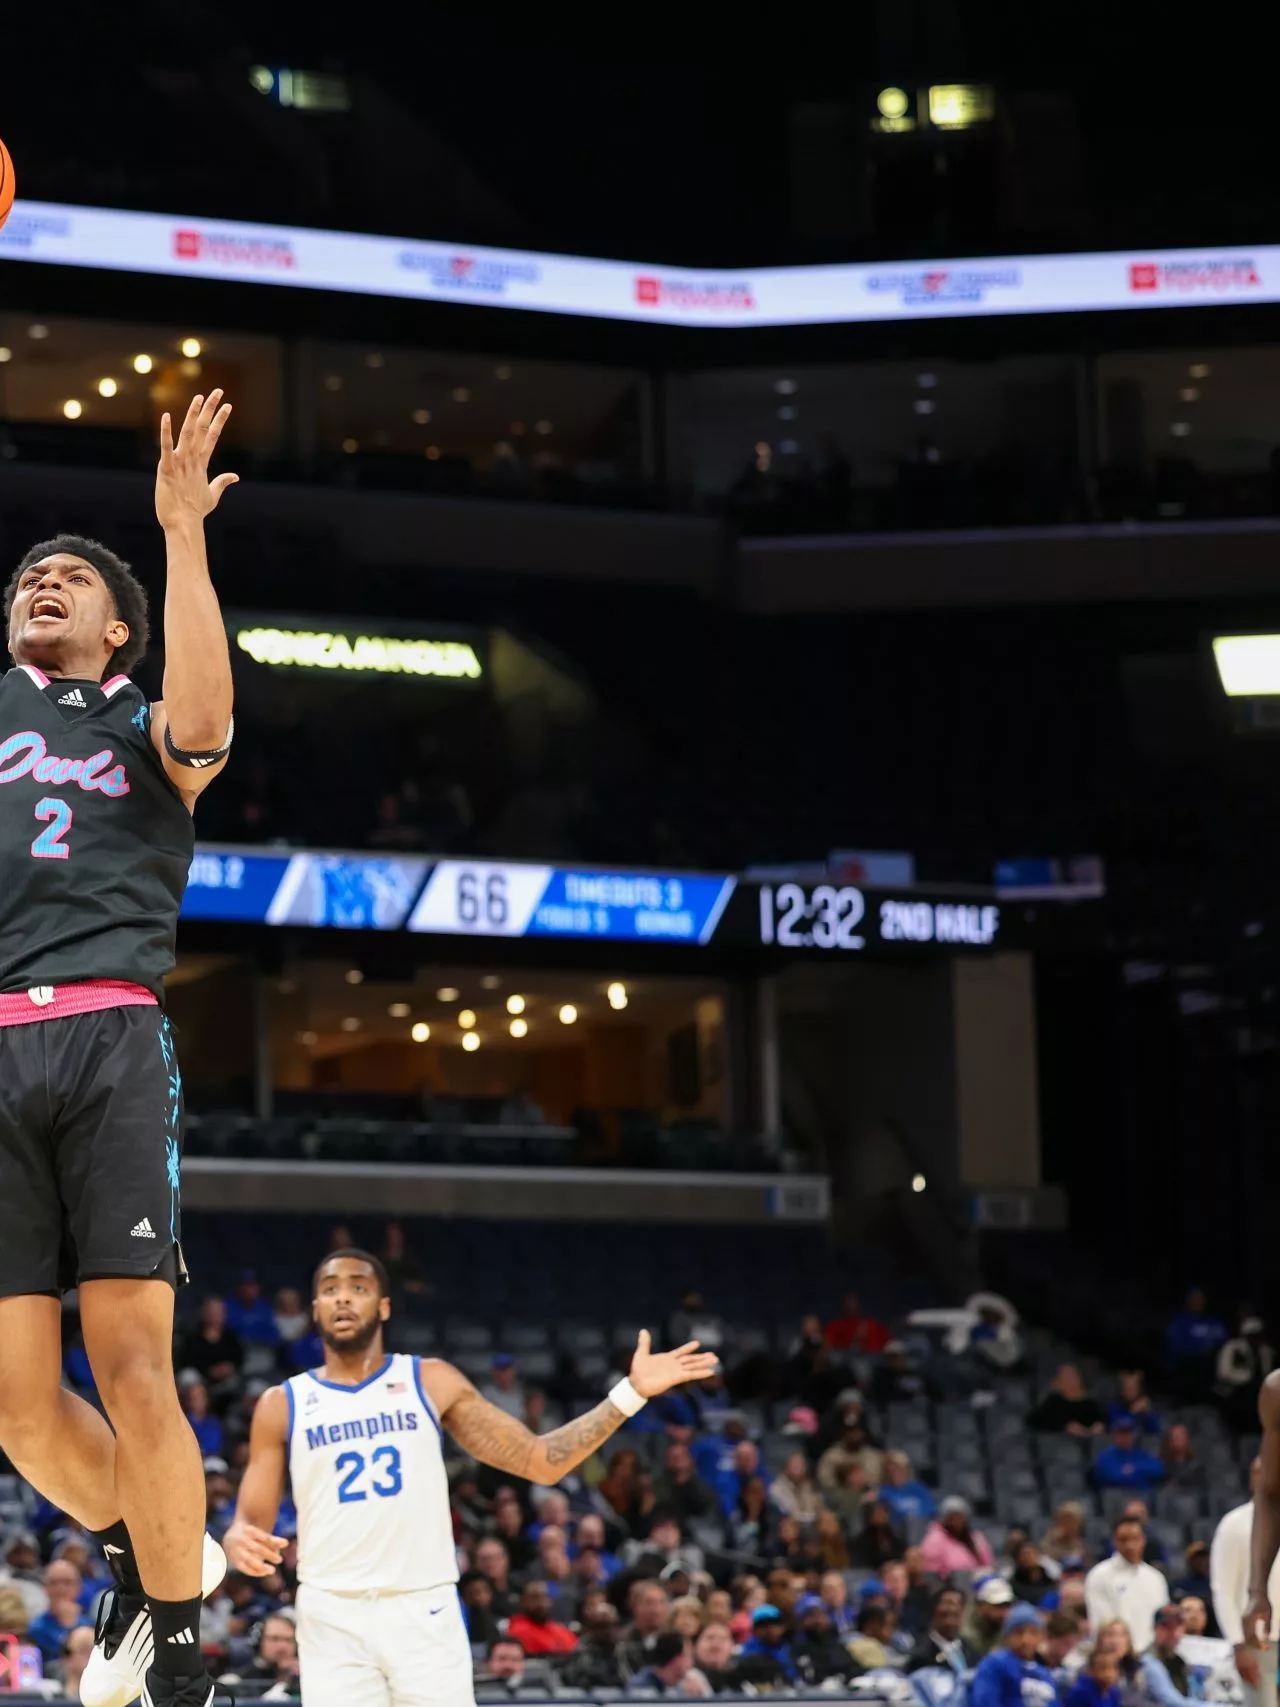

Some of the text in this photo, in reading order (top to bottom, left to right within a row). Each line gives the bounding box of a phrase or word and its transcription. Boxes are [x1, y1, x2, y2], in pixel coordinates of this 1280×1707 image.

[57, 698, 87, 708] adidas
[31, 797, 73, 859] 2
[457, 873, 509, 925] 66
[880, 900, 1000, 944] 2ND HALF
[130, 1229, 156, 1239] adidas
[305, 1409, 418, 1450] Memphis
[335, 1445, 402, 1504] 23
